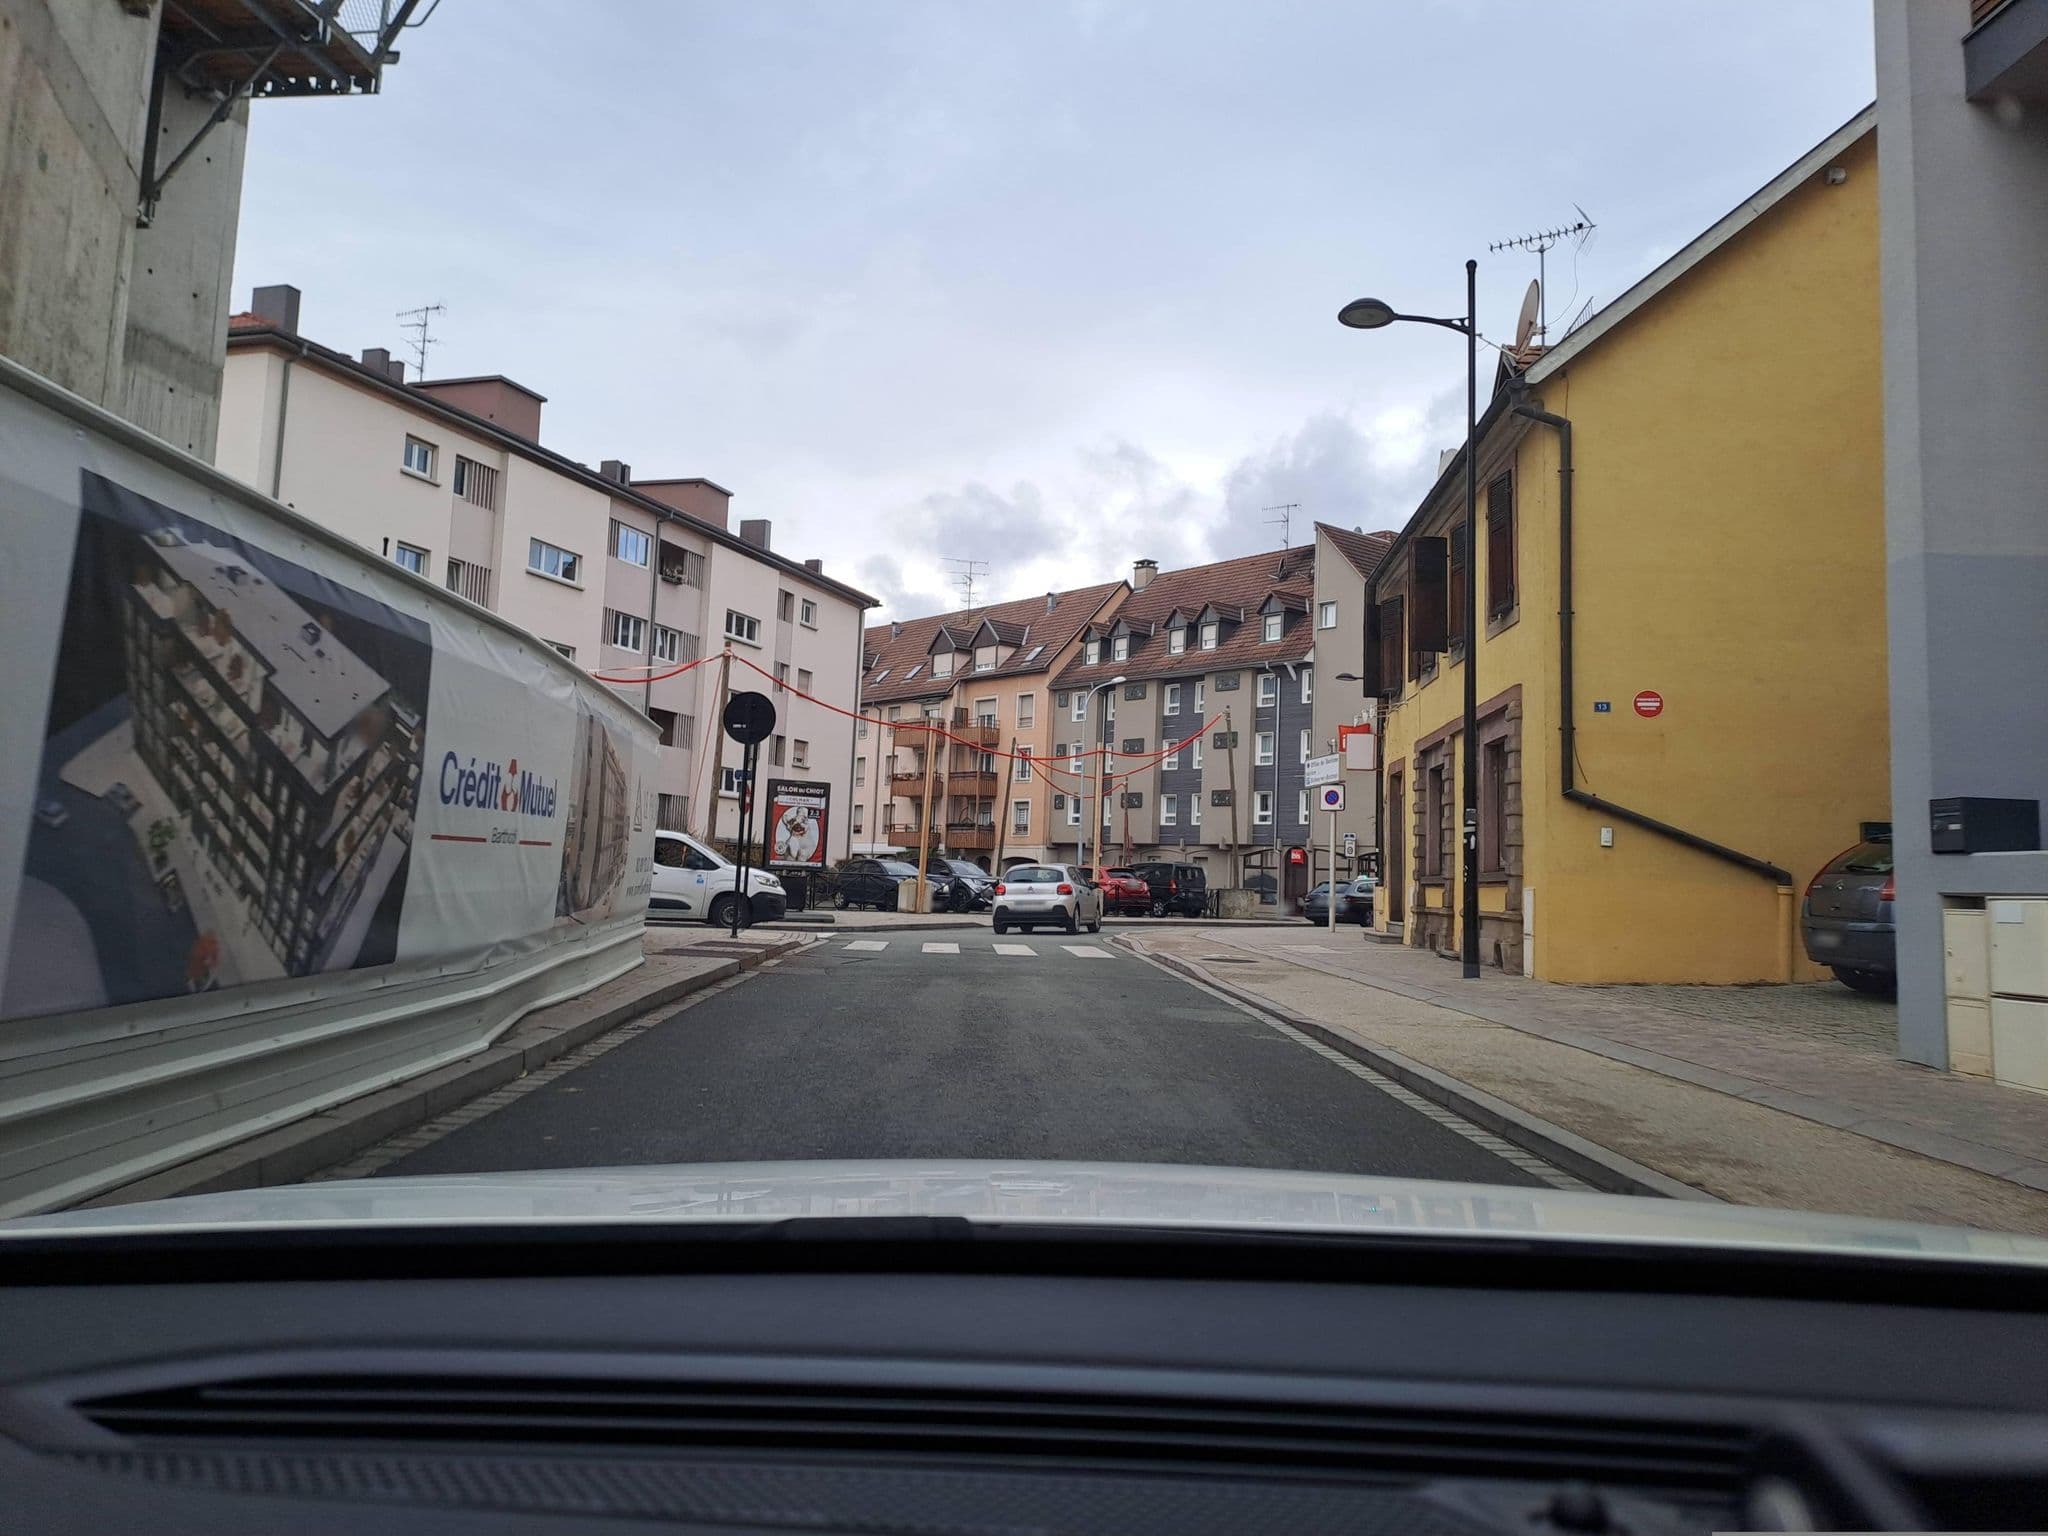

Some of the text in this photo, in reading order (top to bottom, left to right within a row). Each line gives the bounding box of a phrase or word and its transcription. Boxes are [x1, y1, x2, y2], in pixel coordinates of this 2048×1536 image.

[1597, 703, 1608, 711] 13
[440, 751, 557, 818] Crédit Mutuel
[777, 785, 798, 793] SALON
